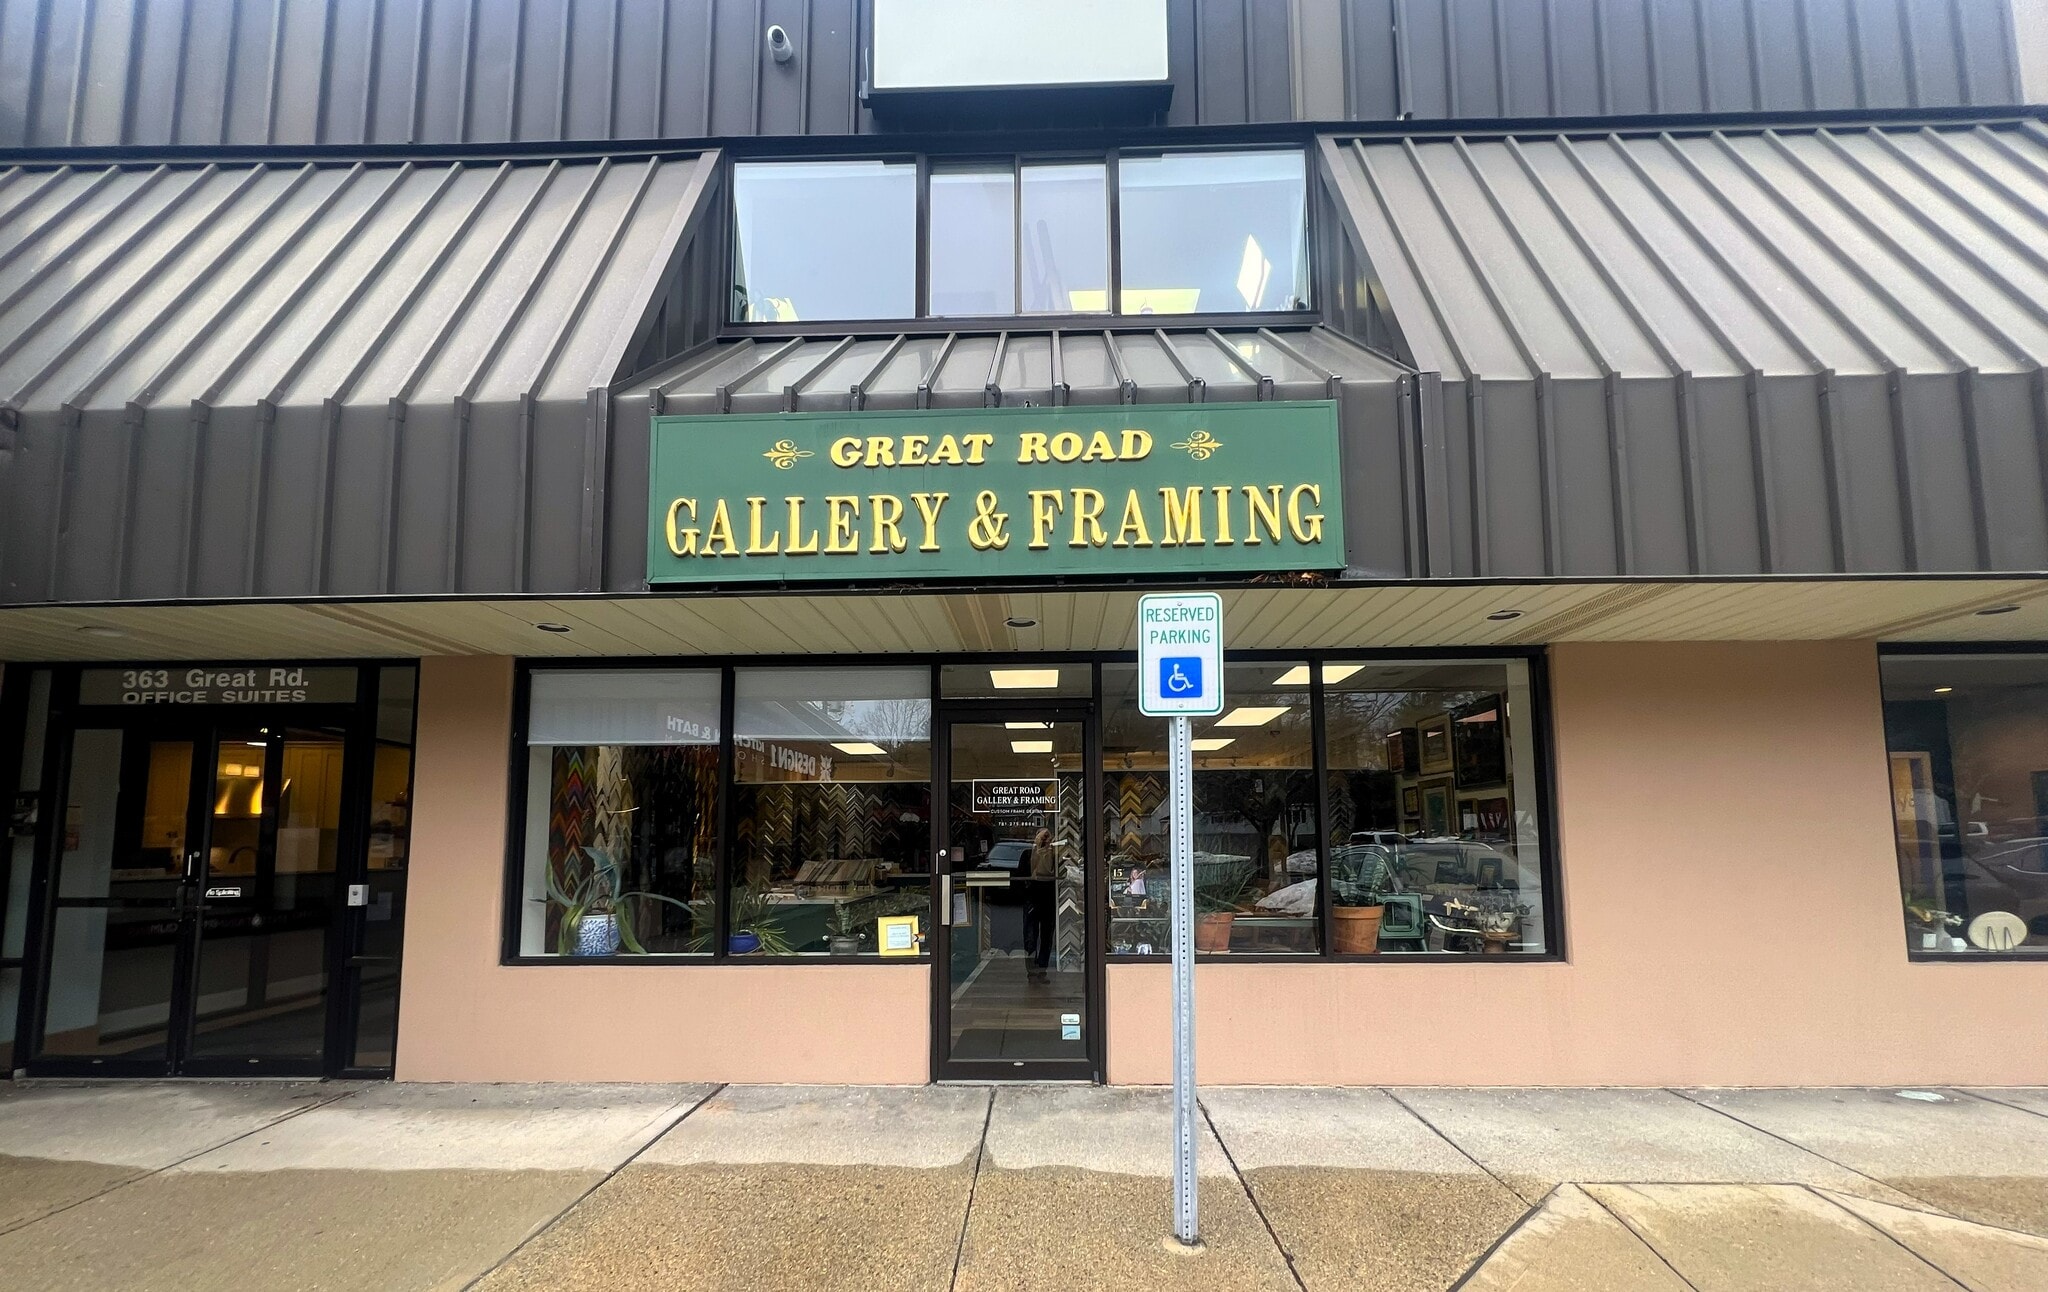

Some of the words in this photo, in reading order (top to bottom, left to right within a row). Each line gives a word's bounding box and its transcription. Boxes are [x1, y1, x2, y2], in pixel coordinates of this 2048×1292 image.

[830, 434, 993, 467] GREAT
[1017, 430, 1153, 463] ROAD
[666, 492, 949, 558] GALLERY
[968, 489, 1010, 550] &
[1028, 484, 1325, 550] FRAMING
[1146, 607, 1214, 622] RESERVED
[1150, 629, 1211, 644] PARKING
[122, 670, 169, 689] 363
[185, 668, 256, 688] Great
[269, 668, 309, 687] Rd.
[122, 691, 207, 704] OFFICE
[222, 690, 306, 703] SUITES
[992, 786, 1018, 795] GREAT
[1019, 786, 1041, 794] ROAD
[976, 796, 1012, 805] GALLERY
[1013, 796, 1019, 804] &
[1020, 796, 1056, 804] FRAMING
